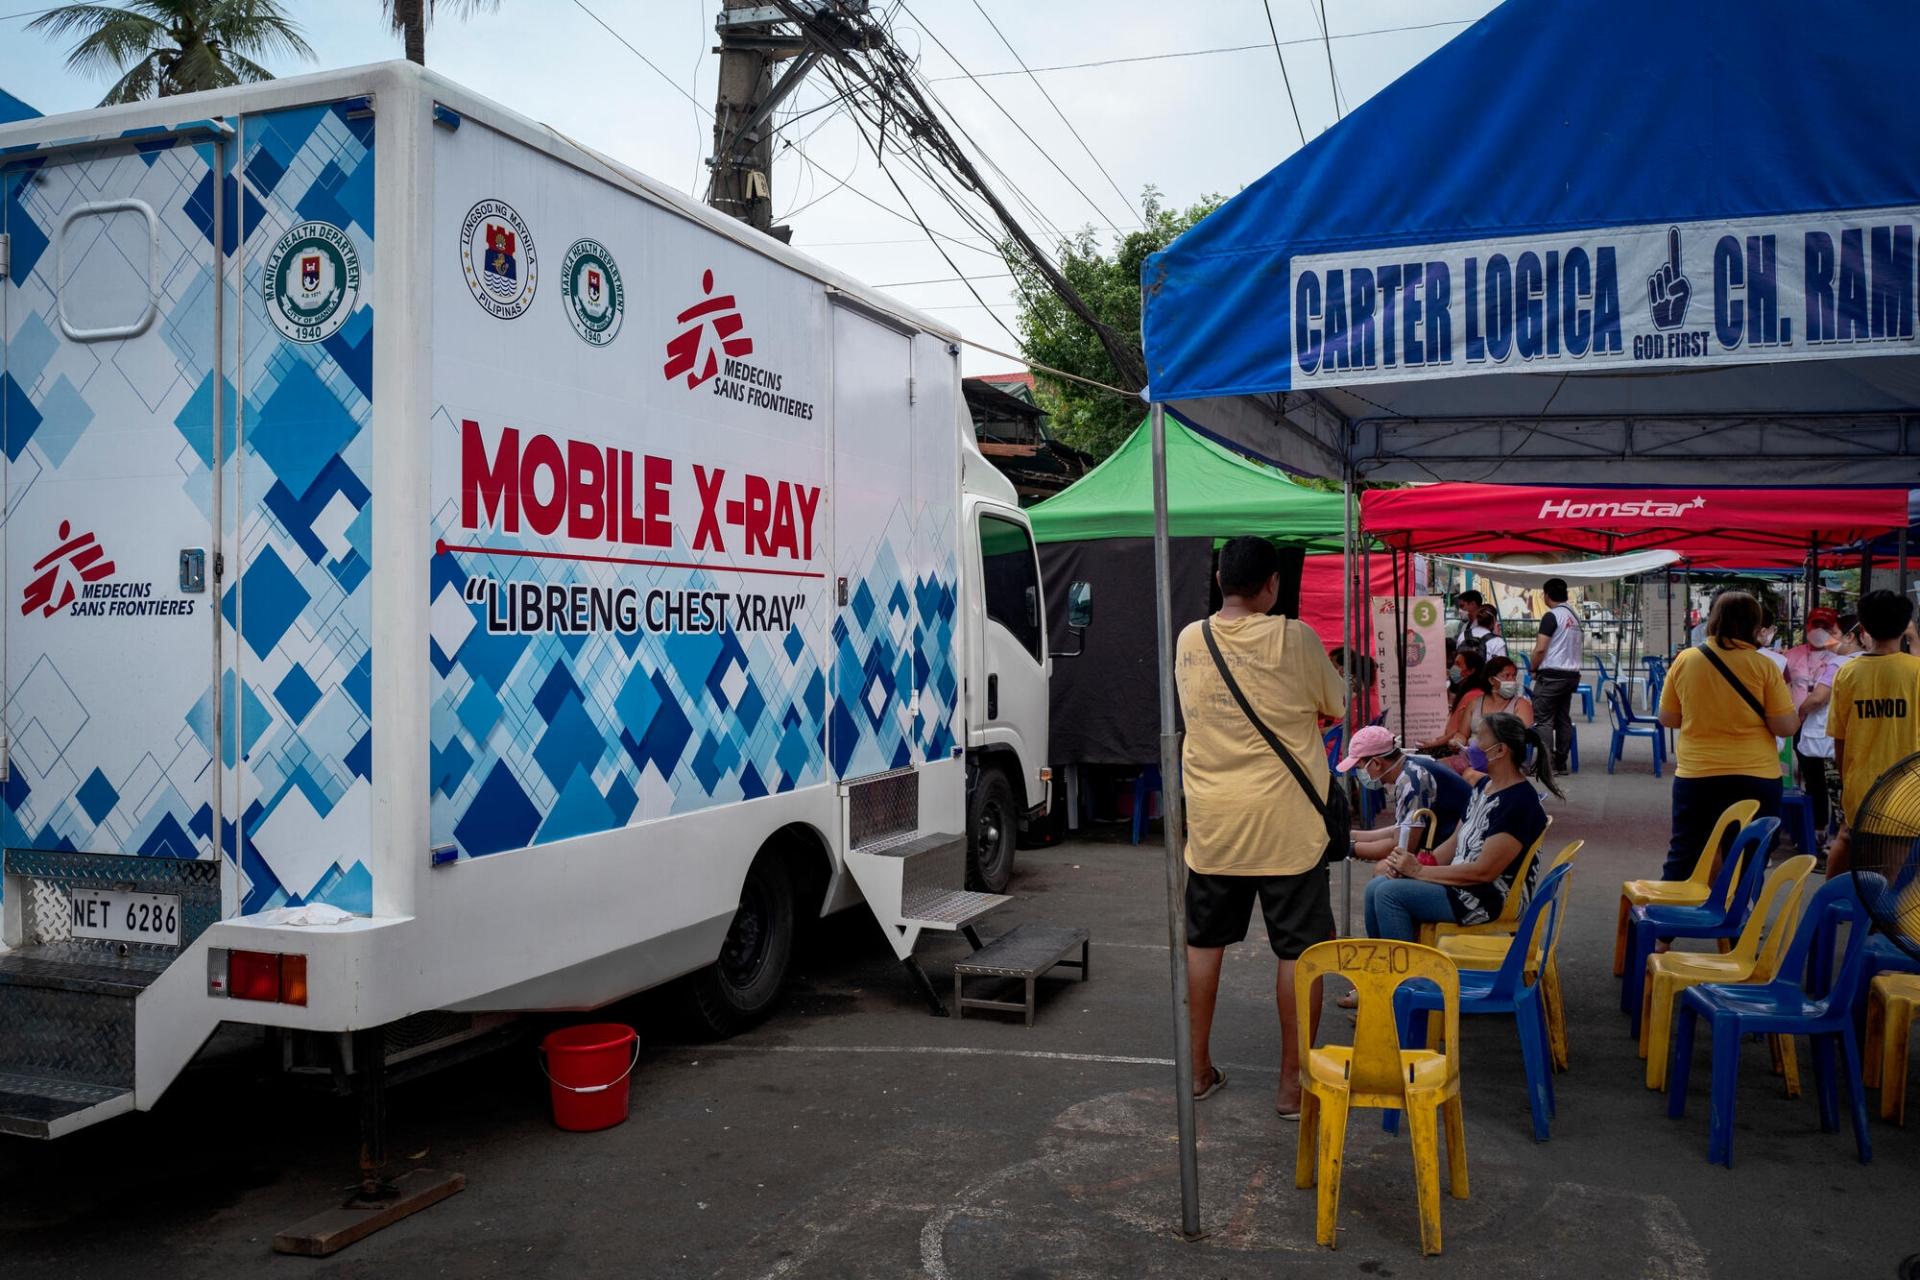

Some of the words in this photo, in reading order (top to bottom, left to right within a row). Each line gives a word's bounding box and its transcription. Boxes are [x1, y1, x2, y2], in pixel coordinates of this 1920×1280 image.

[463, 203, 493, 245] LUNGSOD
[495, 205, 507, 217] NG
[510, 214, 535, 265] MAYNILA
[266, 255, 281, 301] MANILA
[278, 225, 316, 253] HEALTH
[320, 226, 359, 293] DEPARTMENT
[562, 256, 574, 296] MANILA
[572, 243, 597, 256] HEALTH
[599, 249, 623, 315] DEPARTMENT
[478, 292, 521, 317] PILIPINAS
[1296, 261, 1453, 375] CARTER
[1464, 246, 1624, 363] LOGICA
[1714, 234, 1793, 350] CH.
[1804, 224, 1920, 345] RAM
[296, 326, 322, 339] 1940
[584, 329, 601, 343] 1940
[1633, 333, 1664, 360] GOD
[1668, 331, 1710, 359] FIRST
[724, 358, 783, 391] MEDECINS
[713, 377, 745, 401] SANS
[747, 387, 813, 421] FRONTIERES
[461, 419, 673, 548] MOBILE
[692, 464, 821, 560] X-RAY
[1538, 499, 1695, 519] Homstar
[82, 583, 152, 599] MEDECINS
[70, 600, 105, 617] SANS
[109, 599, 195, 616] FRONTIERES
[645, 589, 730, 632] CHEST
[1421, 607, 1430, 621] 3
[1854, 698, 1907, 719] TANOD
[74, 899, 111, 928] NET
[126, 902, 176, 933] 6286
[1336, 943, 1410, 974] 127-10
